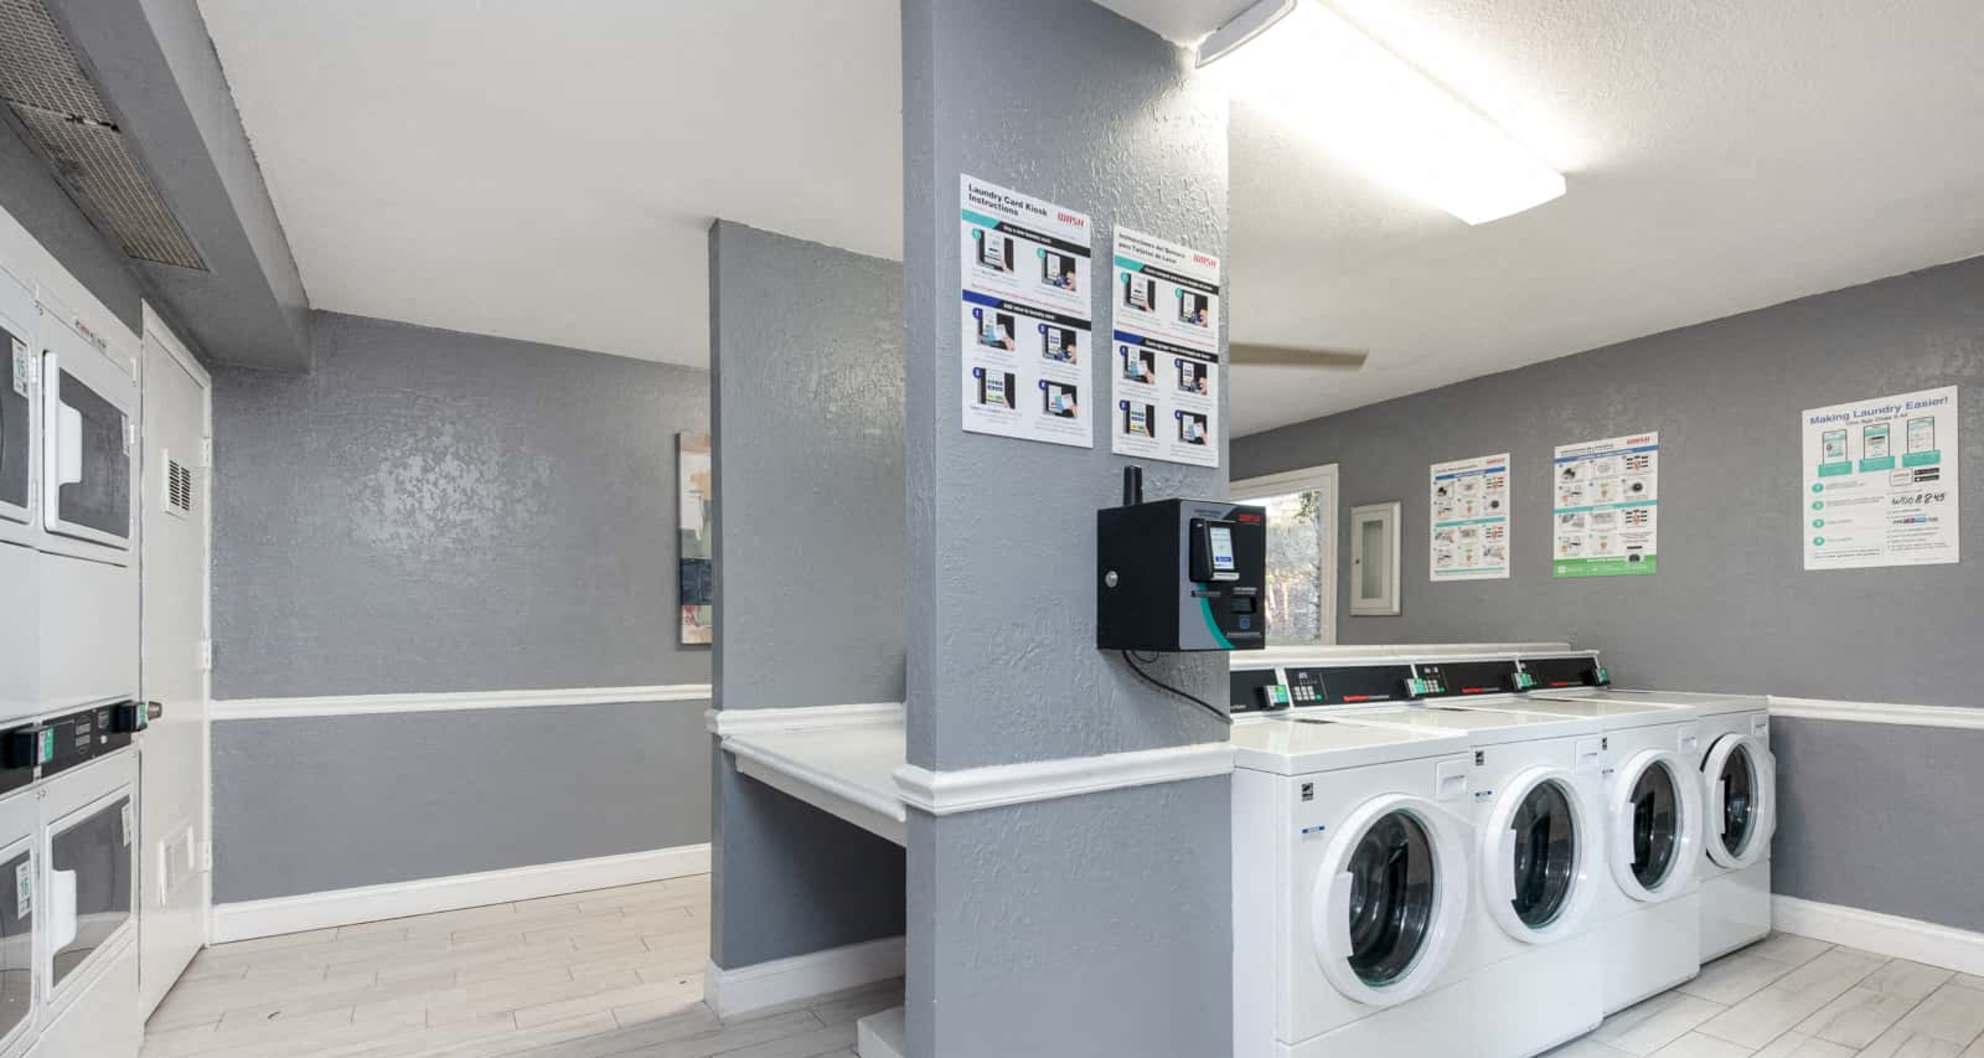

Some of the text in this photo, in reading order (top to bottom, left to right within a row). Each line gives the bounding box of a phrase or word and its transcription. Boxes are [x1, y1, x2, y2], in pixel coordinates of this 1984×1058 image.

[968, 184, 1047, 216] Laundry Card Kiosk
[968, 193, 1018, 216] Instructions
[1809, 412, 1849, 425] Making
[1853, 404, 1902, 418] Laundry
[1905, 396, 1948, 410] Easier!
